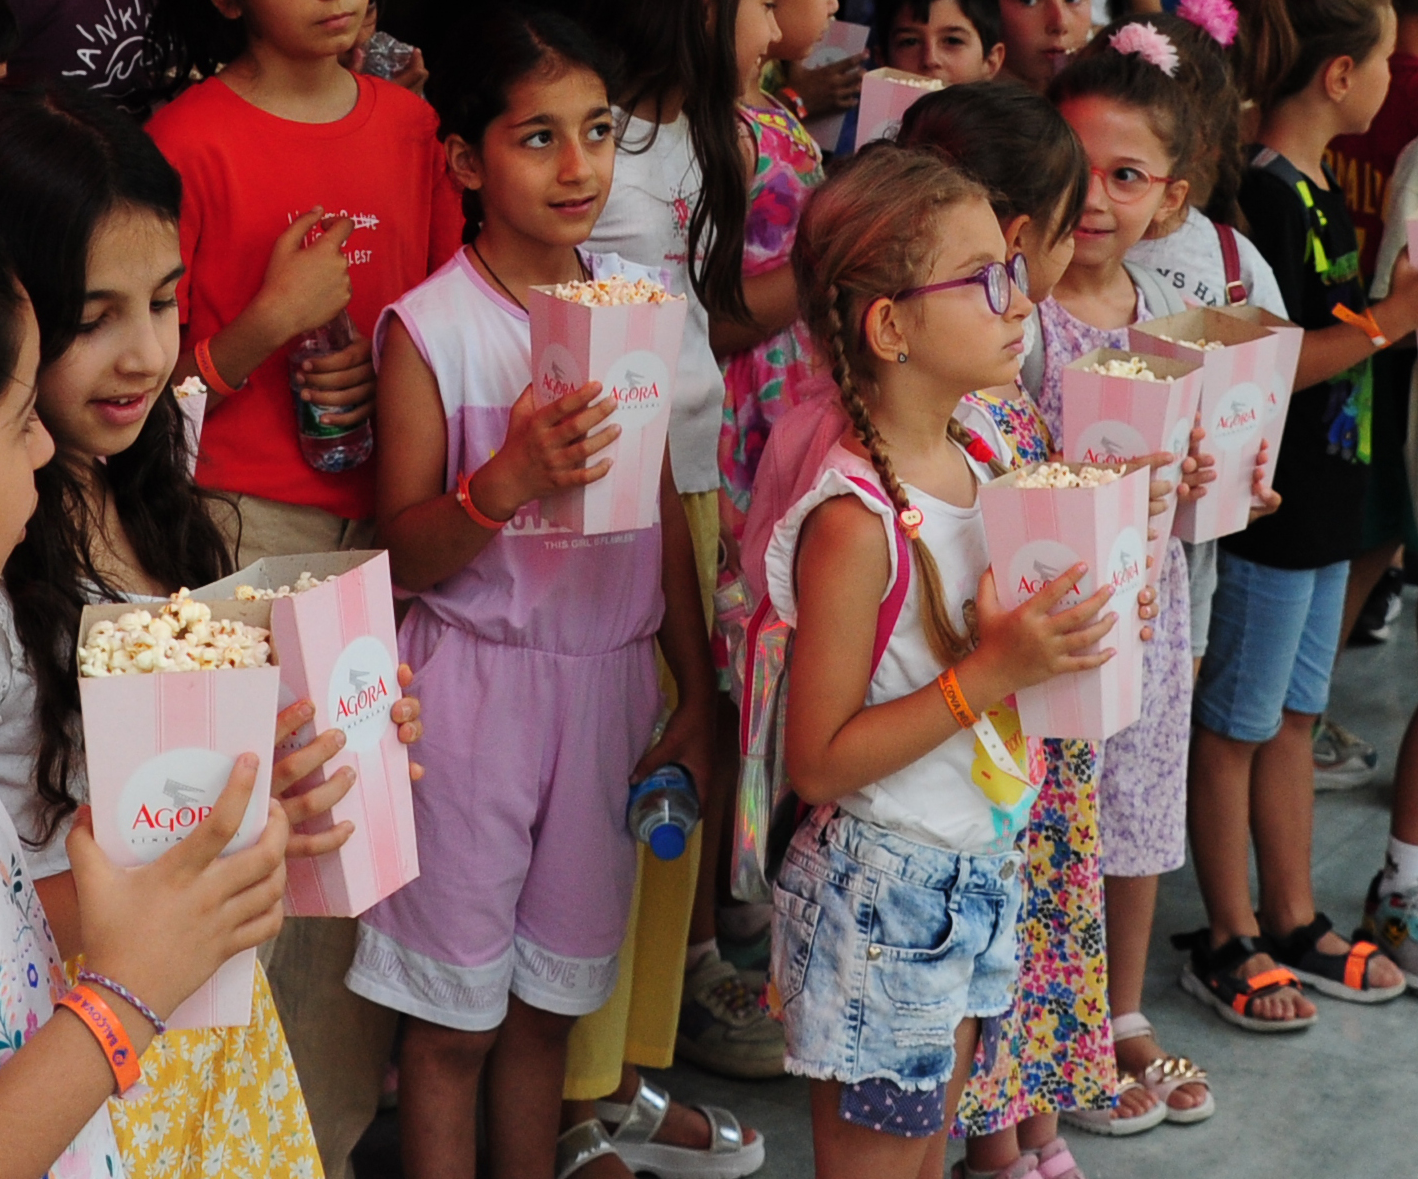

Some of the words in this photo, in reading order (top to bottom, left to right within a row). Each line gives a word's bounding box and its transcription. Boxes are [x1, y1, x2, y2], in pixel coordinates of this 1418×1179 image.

[609, 381, 659, 403] AGORA
[336, 675, 388, 722] AGORA
[131, 803, 214, 832] AGOR
